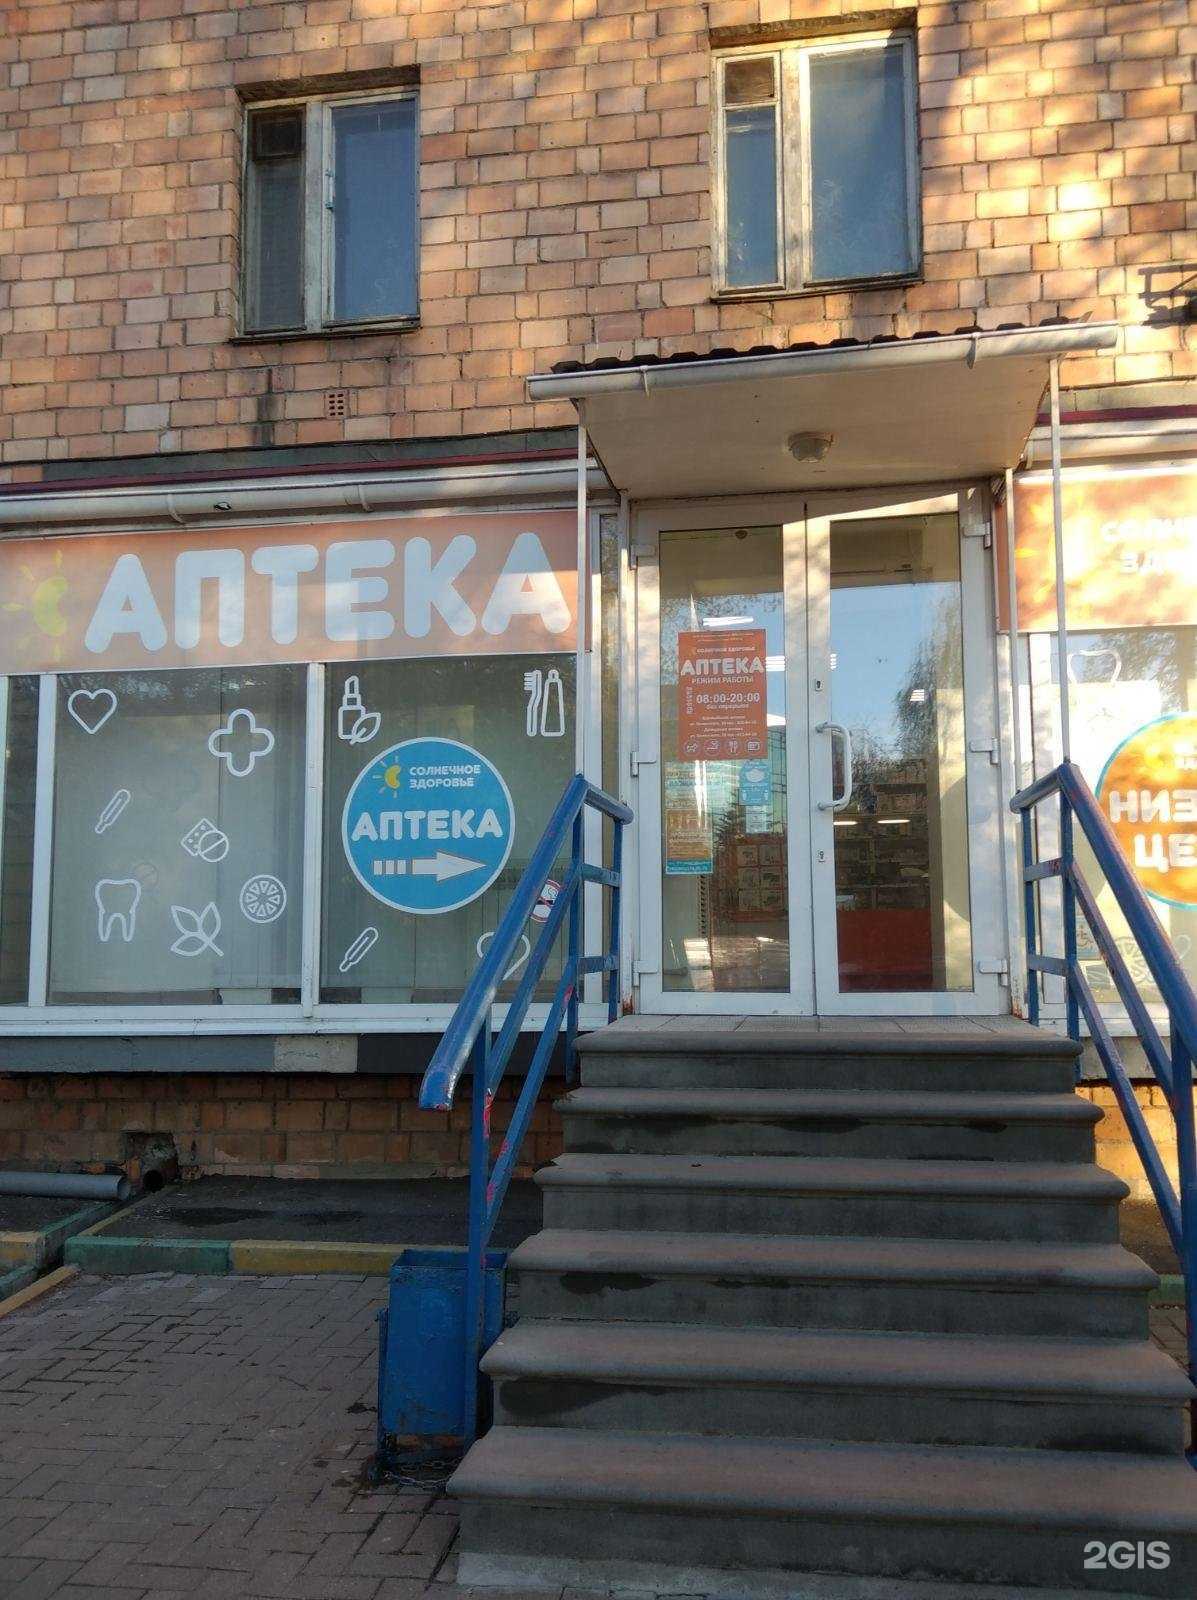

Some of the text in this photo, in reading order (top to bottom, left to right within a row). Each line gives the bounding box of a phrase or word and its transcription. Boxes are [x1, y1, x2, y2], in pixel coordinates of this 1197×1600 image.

[84, 531, 572, 654] АПТЕКА
[680, 656, 765, 676] АПТЕКА
[722, 675, 754, 684] РАБОТЫ
[409, 764, 481, 777] СОЛНЕЧНОЕ
[409, 777, 475, 790] ЗДОРОВЬЕ
[351, 808, 504, 842] АПТЕКА
